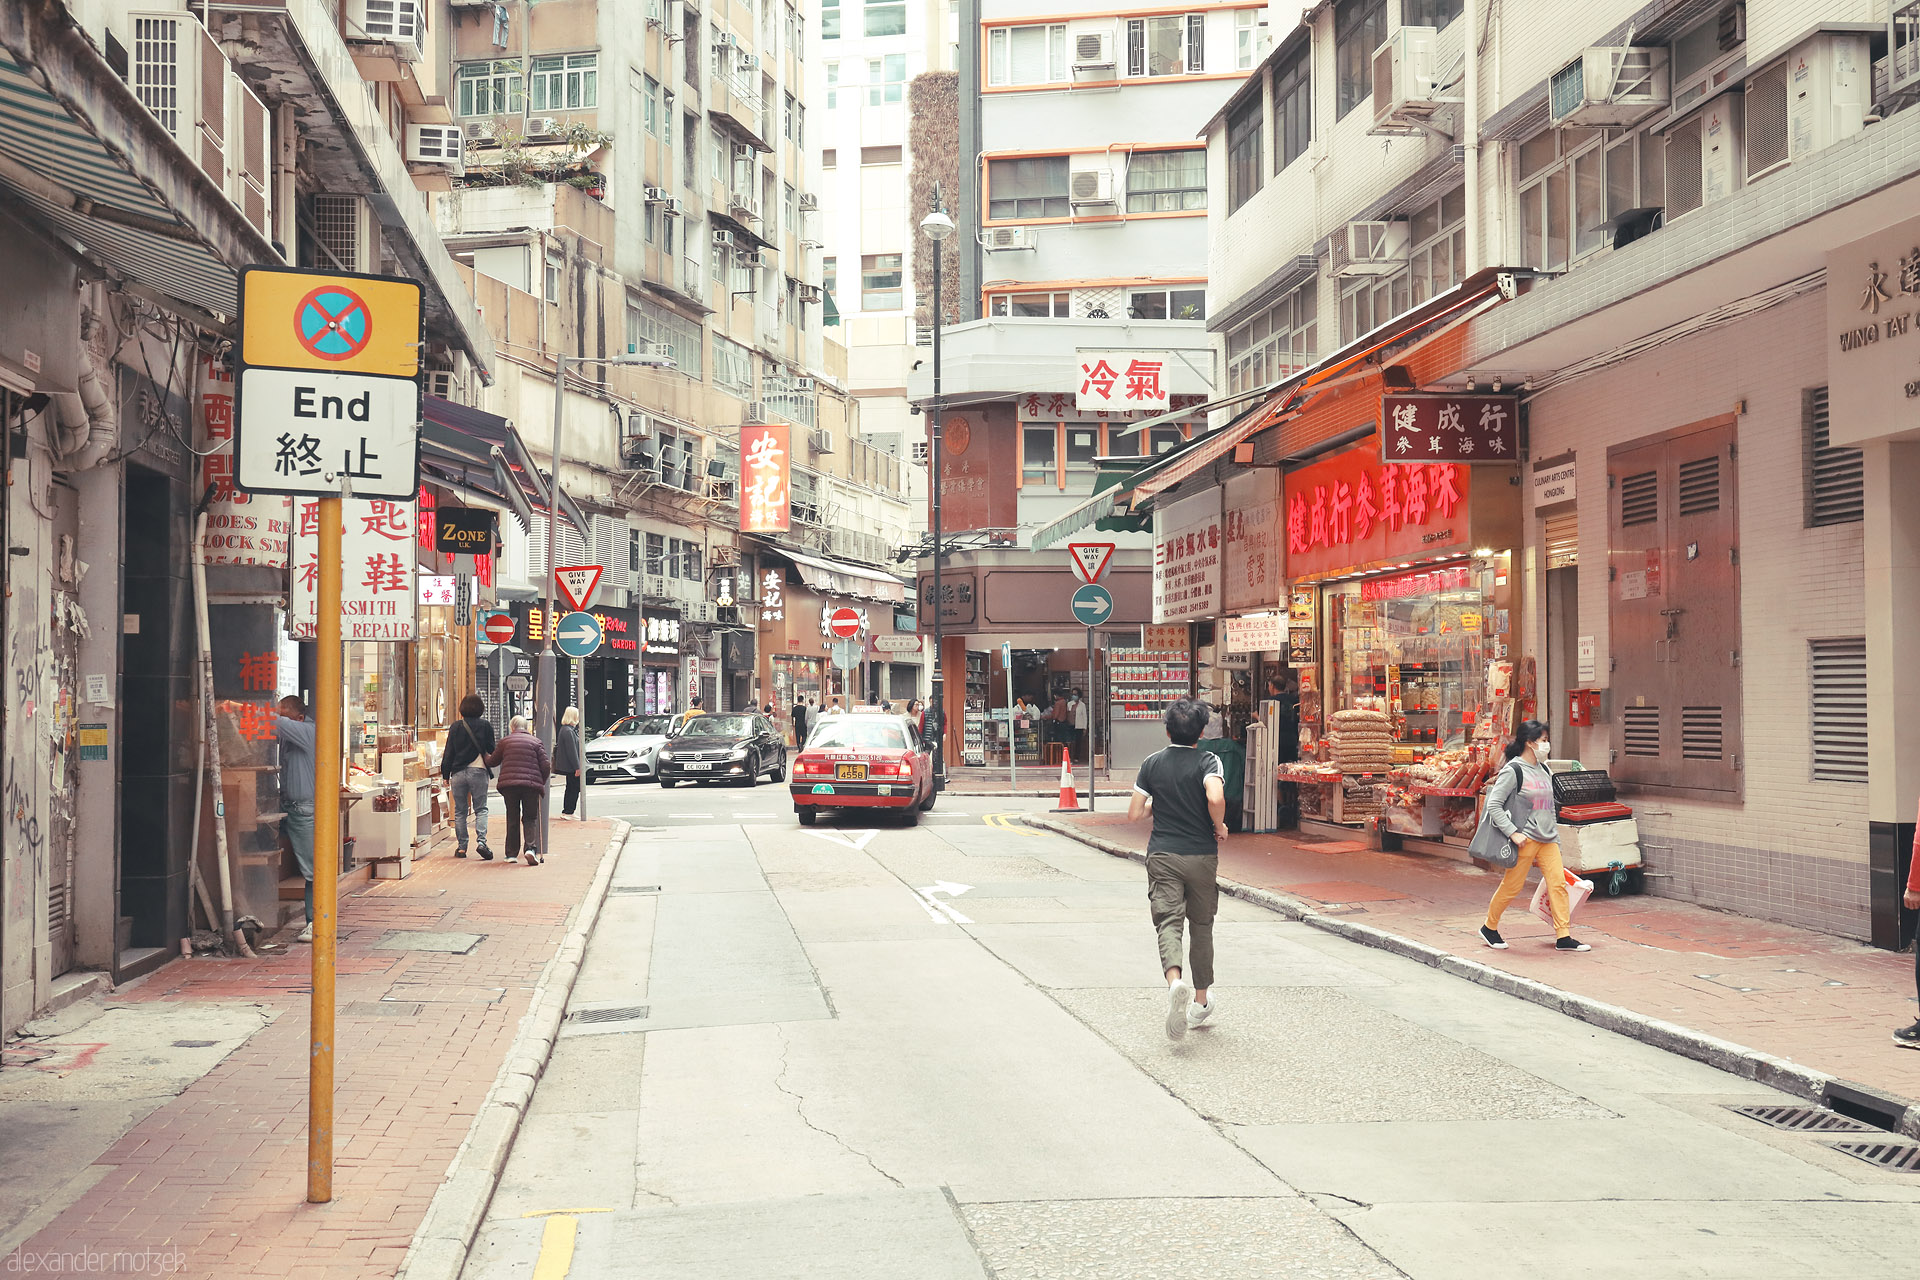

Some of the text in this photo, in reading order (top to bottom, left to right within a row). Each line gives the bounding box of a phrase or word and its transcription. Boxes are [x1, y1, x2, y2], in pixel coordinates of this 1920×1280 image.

[1840, 313, 1911, 352] WING TAT
[1080, 359, 1166, 401] 冷氣
[294, 386, 371, 422] End
[1392, 403, 1508, 433] 健成行
[274, 432, 383, 480] 終止
[1395, 435, 1507, 455] 參茸海味
[745, 431, 785, 507] 安記
[1534, 468, 1575, 487] CULINARY ARTS CENTRE
[206, 514, 258, 530] HOES
[762, 570, 783, 607] 安記
[309, 600, 397, 616] LKSMITH
[352, 623, 411, 638] REPAIR
[611, 638, 637, 650] GARDEN
[239, 651, 279, 741] 補鞋
[689, 658, 699, 709] 美洲人民
[840, 771, 863, 779] 4558
